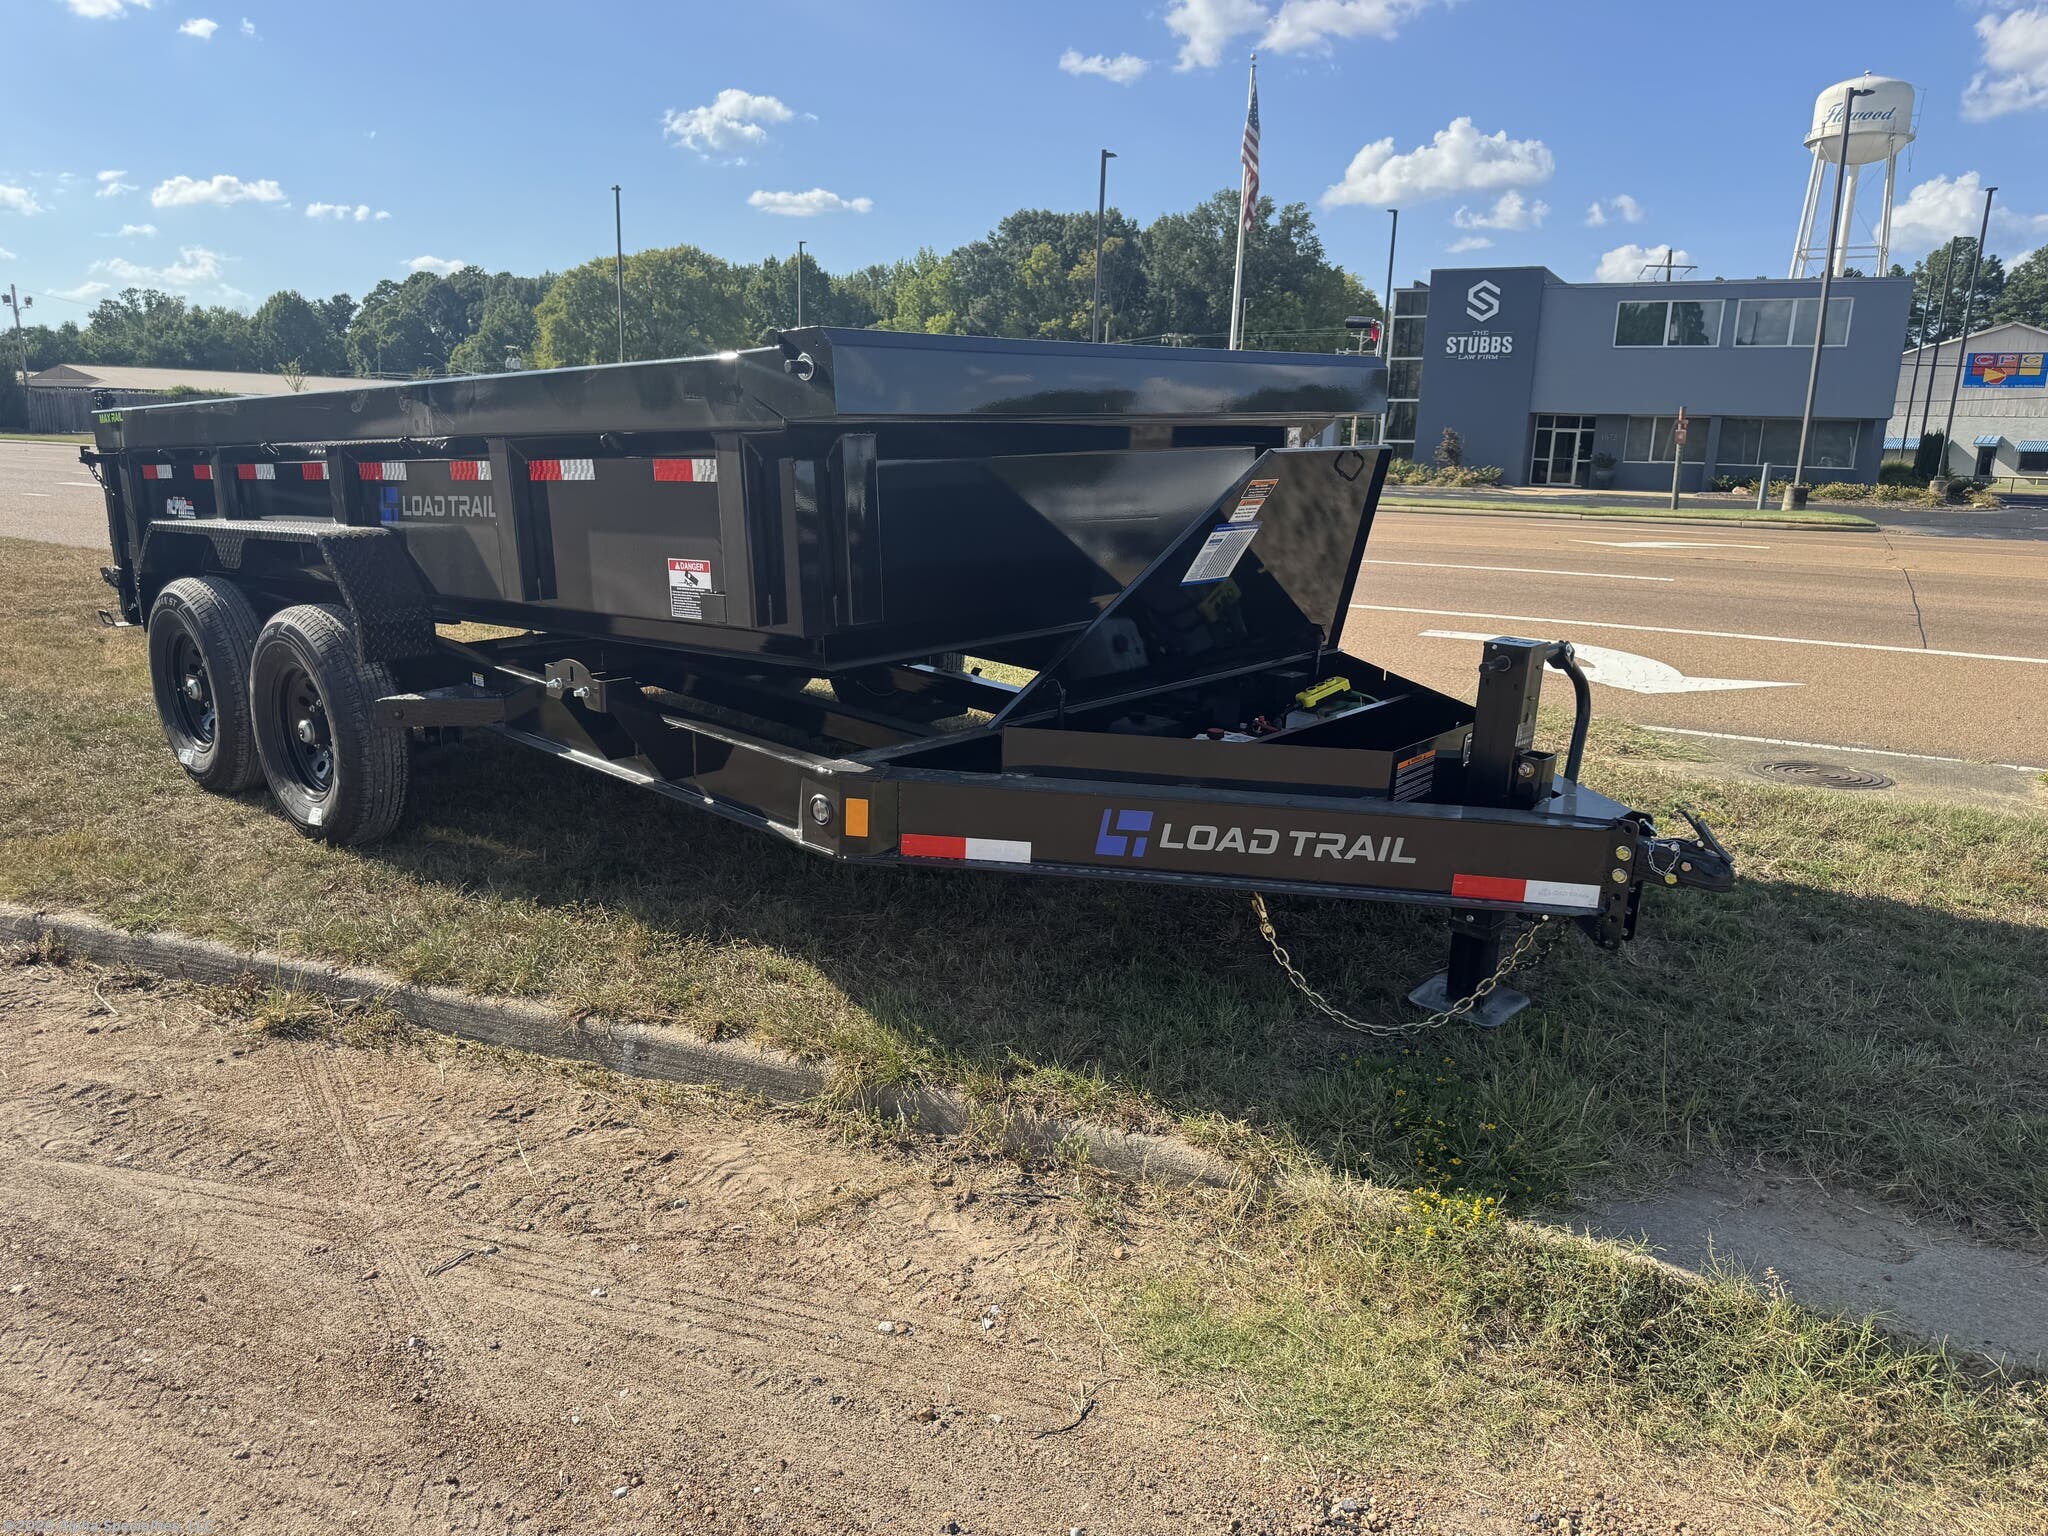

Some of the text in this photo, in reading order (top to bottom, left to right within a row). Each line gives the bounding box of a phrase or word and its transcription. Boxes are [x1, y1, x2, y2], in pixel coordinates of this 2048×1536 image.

[1446, 336, 1513, 353] STUBBS
[402, 495, 497, 518] LOAD TRAIL
[680, 561, 705, 572] DANGER
[1159, 823, 1417, 864] LOAD TRAIL
